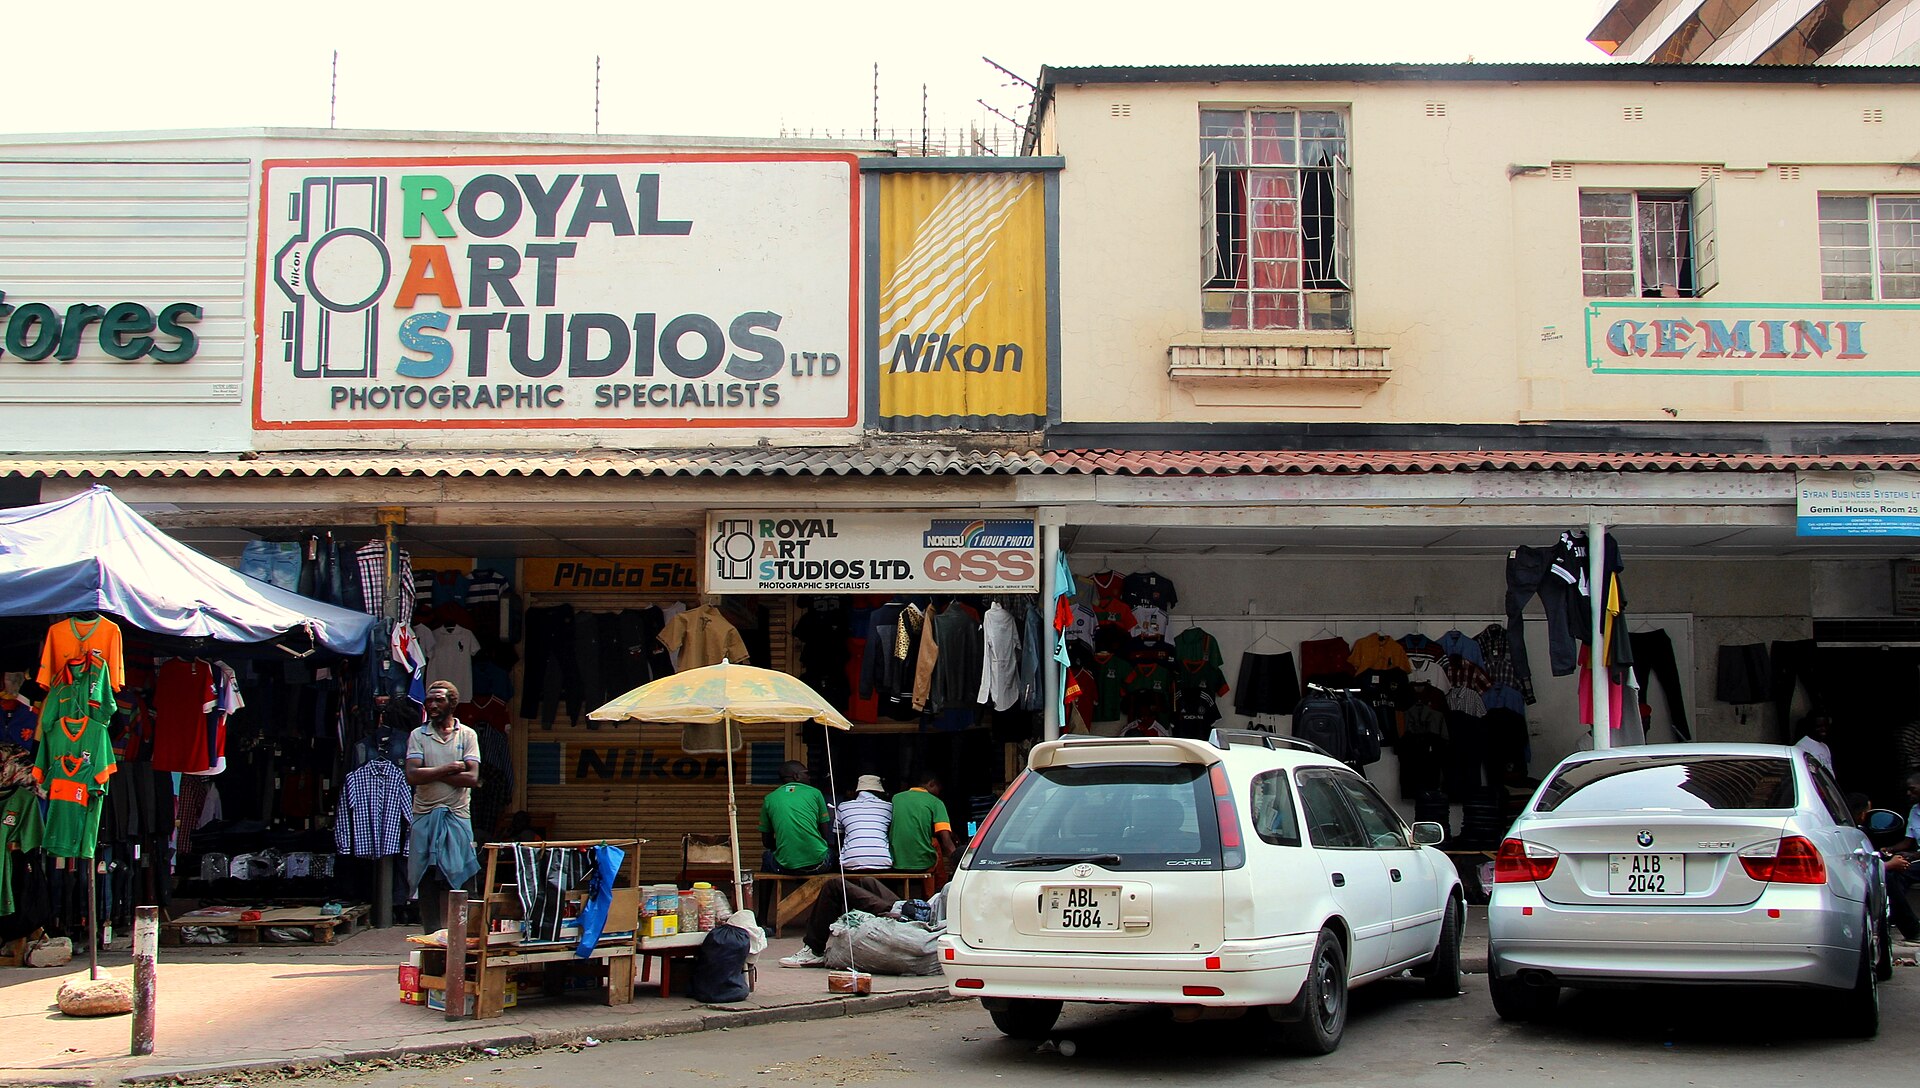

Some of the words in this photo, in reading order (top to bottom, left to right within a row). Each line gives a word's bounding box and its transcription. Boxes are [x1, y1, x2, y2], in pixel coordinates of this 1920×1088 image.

[401, 174, 693, 238] ROYAL
[291, 251, 300, 287] Nikon
[394, 242, 577, 308] ART
[0, 289, 203, 364] ores
[395, 311, 785, 380] STUDIOS
[791, 351, 841, 377] LTD
[1605, 316, 1868, 360] GEMINI
[889, 332, 1023, 374] Nikon
[331, 384, 564, 410] PHOTOGRAPHIC
[595, 382, 780, 408] SPECIALISTS
[1802, 490, 1829, 499] SYRAN
[1831, 490, 1871, 499] BUSINESS
[1873, 490, 1909, 499] SYSTEMS
[1809, 505, 1843, 513] Gemini
[1845, 505, 1878, 514] House,
[1880, 505, 1906, 513] Room
[758, 519, 838, 538] ROYAL
[759, 540, 810, 558] ART
[927, 535, 965, 548] NORITSU
[973, 536, 979, 546] 1
[980, 535, 1004, 547] HOUR
[1004, 535, 1034, 547] PHOTO
[554, 562, 644, 587] Photo
[759, 559, 865, 581] STUDIOS
[869, 560, 914, 580] LTD.
[923, 549, 1035, 582] QSS
[758, 581, 822, 589] PHOTOGRAPHIC
[825, 581, 870, 589] SPECIALISTS
[576, 748, 737, 780] Nikon
[1632, 855, 1660, 873] AIB
[1628, 875, 1665, 892] 2042
[1068, 888, 1098, 907] ABL
[1063, 909, 1101, 928] 5084
